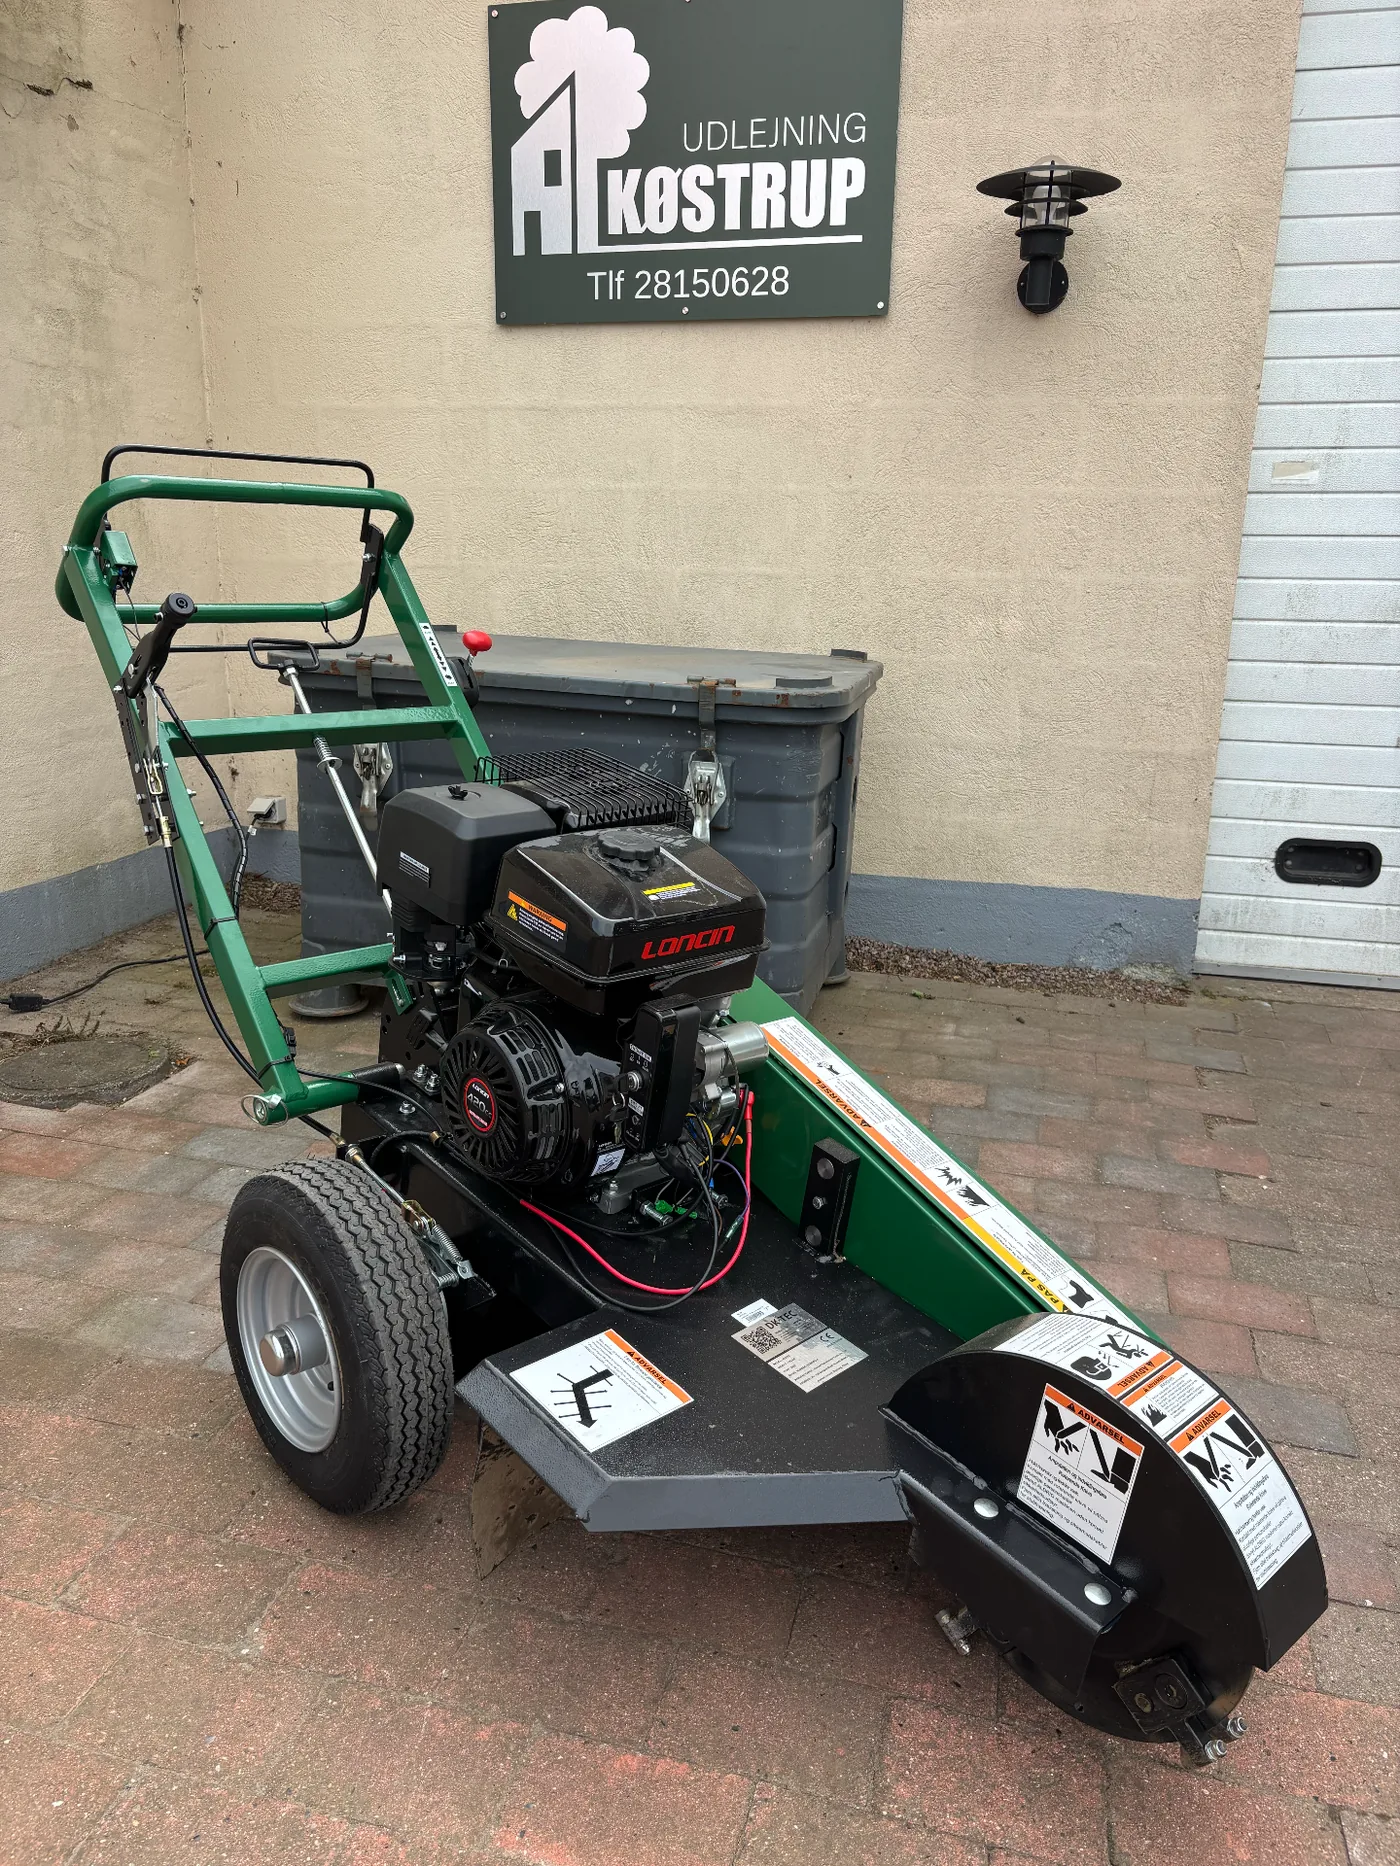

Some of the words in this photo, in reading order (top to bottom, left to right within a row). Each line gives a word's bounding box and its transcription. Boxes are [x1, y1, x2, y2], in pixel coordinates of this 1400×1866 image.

[683, 112, 867, 153] UDLEJNING
[607, 156, 866, 235] KØSTRUP
[587, 269, 625, 300] Tlf
[634, 265, 790, 299] 28150628
[641, 925, 735, 960] LONCIN
[816, 1079, 861, 1119] ADVARSEL
[1037, 1284, 1059, 1304] PAS
[635, 1357, 667, 1384] ADVARSEL
[1117, 1366, 1149, 1388] ADVARSEL
[1078, 1409, 1124, 1444] ADVARSEL
[1192, 1410, 1221, 1436] ADVARSEL
